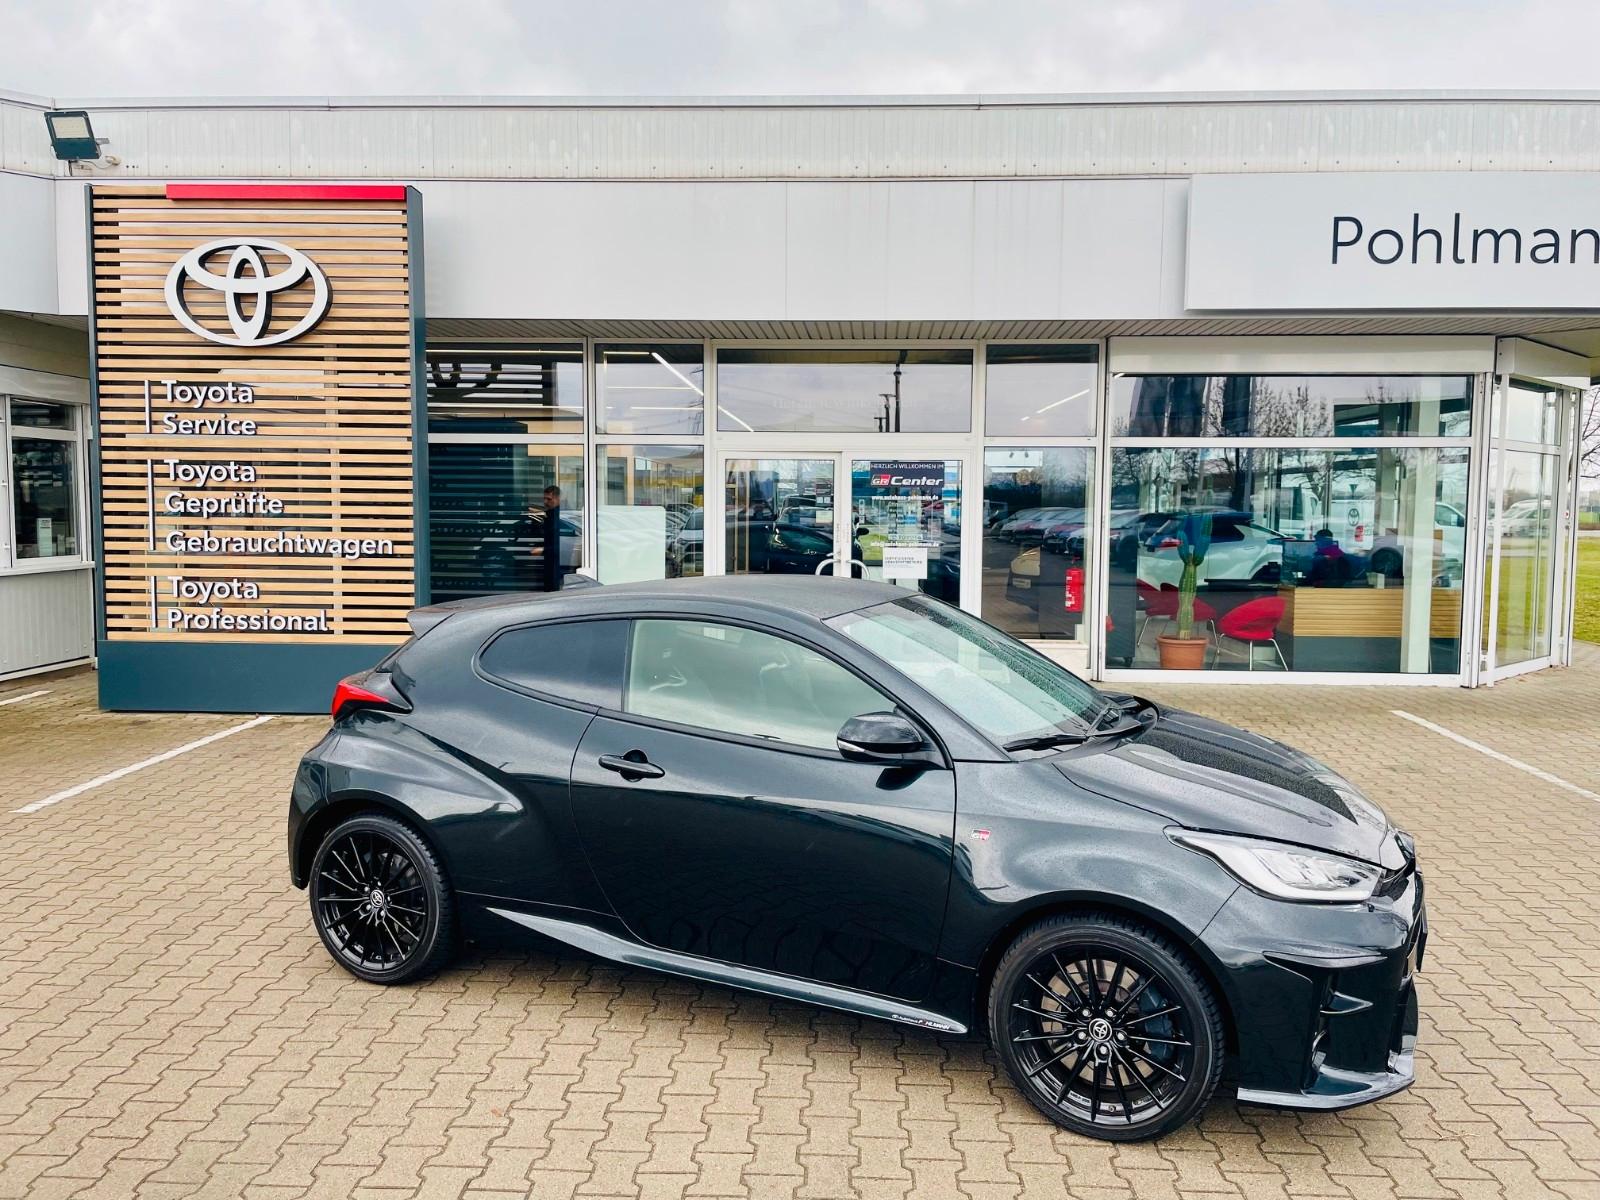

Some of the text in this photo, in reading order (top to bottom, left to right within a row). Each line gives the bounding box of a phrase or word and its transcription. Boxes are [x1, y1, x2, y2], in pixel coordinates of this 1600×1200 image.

[1331, 213, 1600, 265] Pohlman
[161, 380, 255, 408] Toyota
[162, 413, 257, 436] Service
[163, 459, 257, 487] Toyota
[871, 476, 943, 486] GR Center
[165, 491, 284, 519] Geprüfte
[166, 531, 394, 560] Gebrauchtwagen
[168, 576, 260, 604] Toyota
[167, 609, 329, 633] Professional
